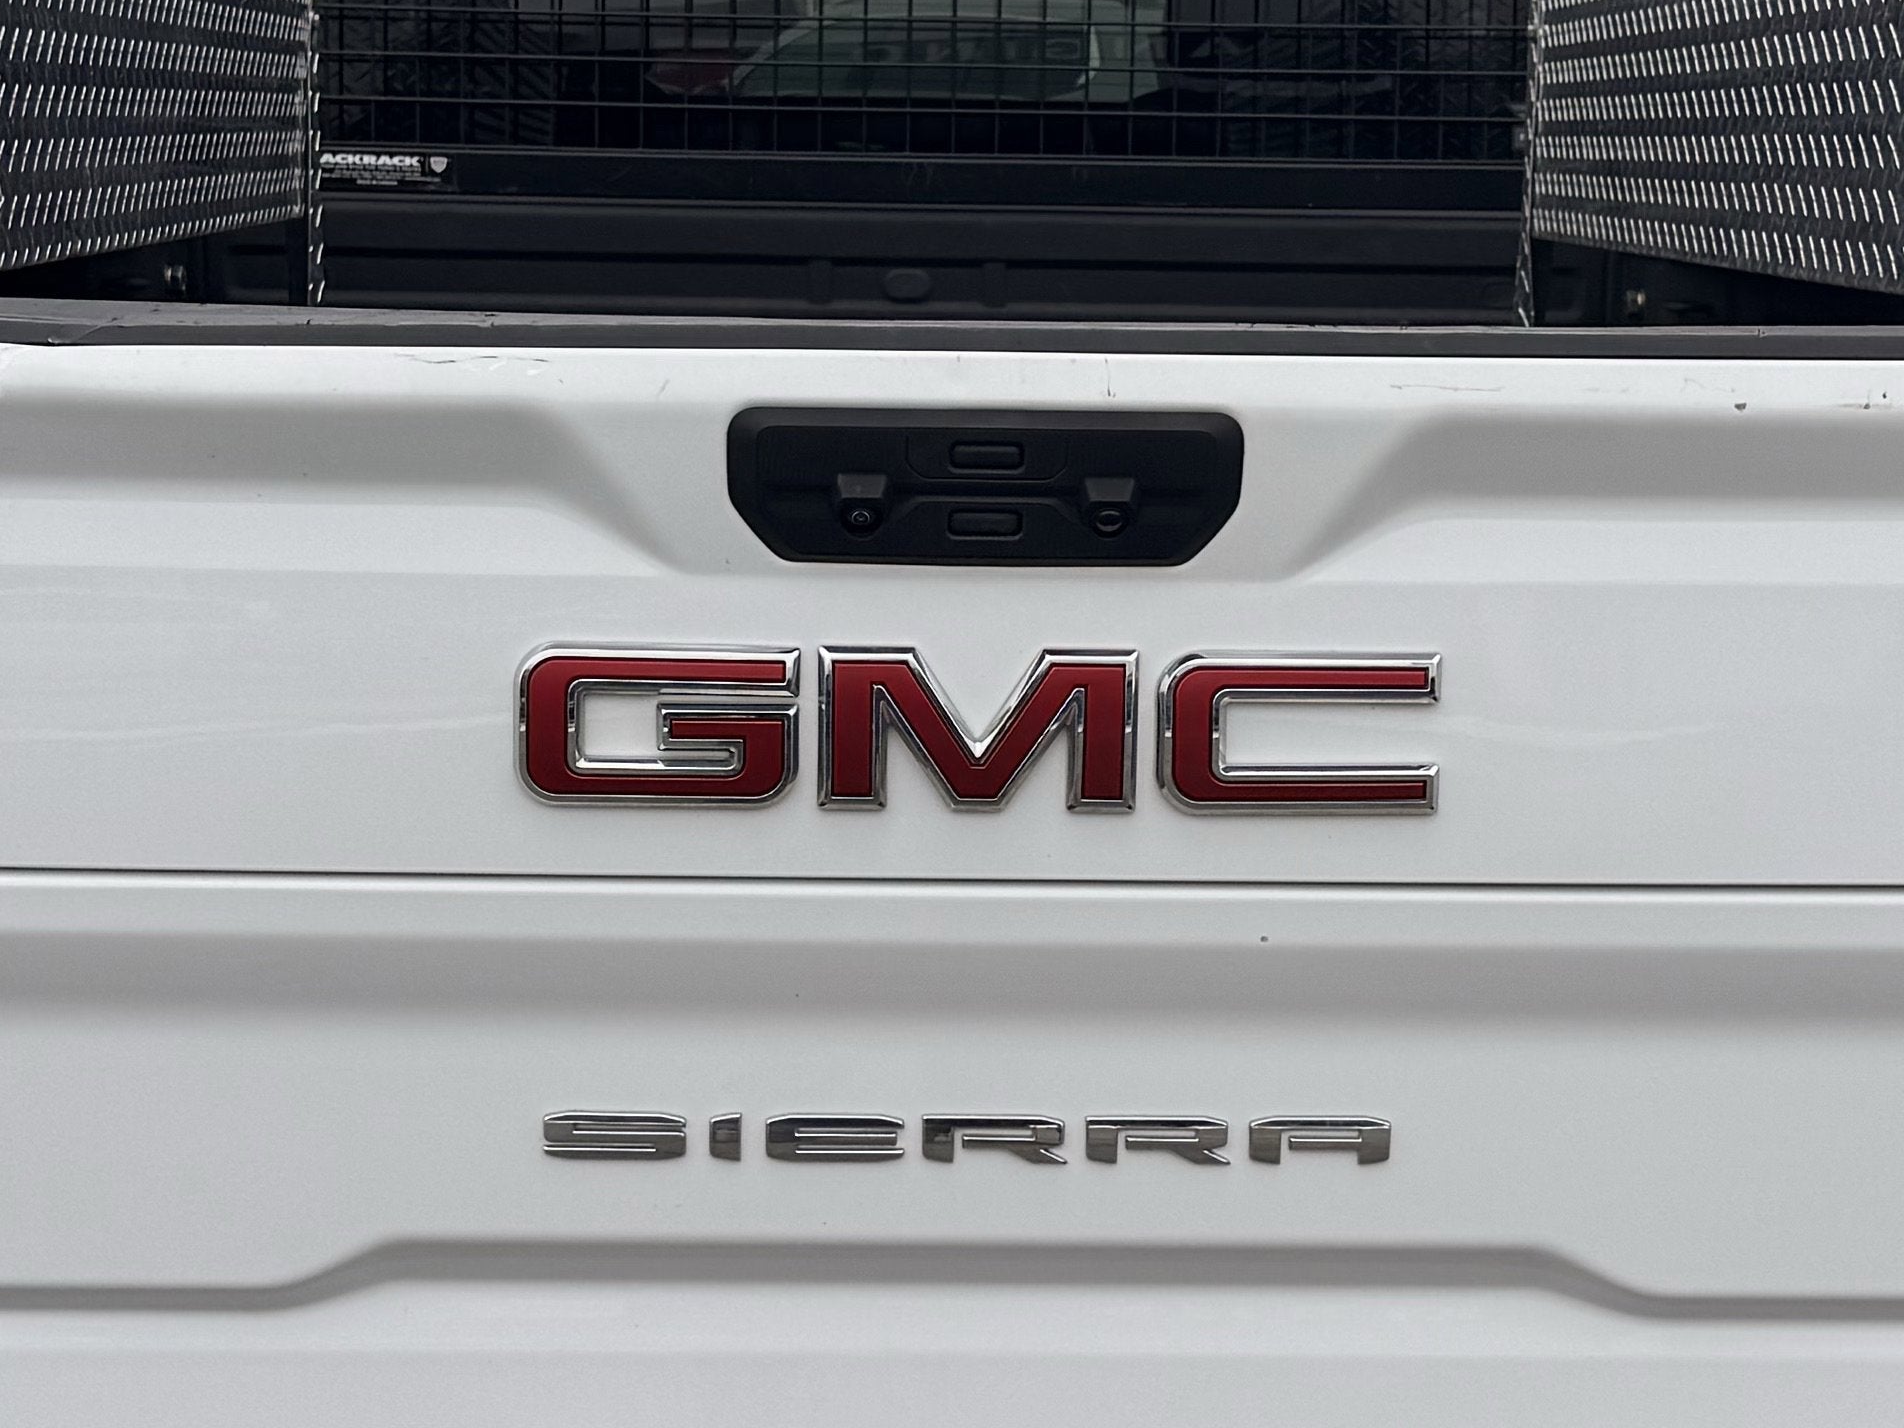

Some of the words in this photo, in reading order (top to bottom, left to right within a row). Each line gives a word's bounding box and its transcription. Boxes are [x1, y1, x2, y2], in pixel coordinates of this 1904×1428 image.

[320, 153, 421, 166] ACKRACK
[515, 641, 1442, 814] GMC
[542, 1110, 1392, 1165] SIERRA
